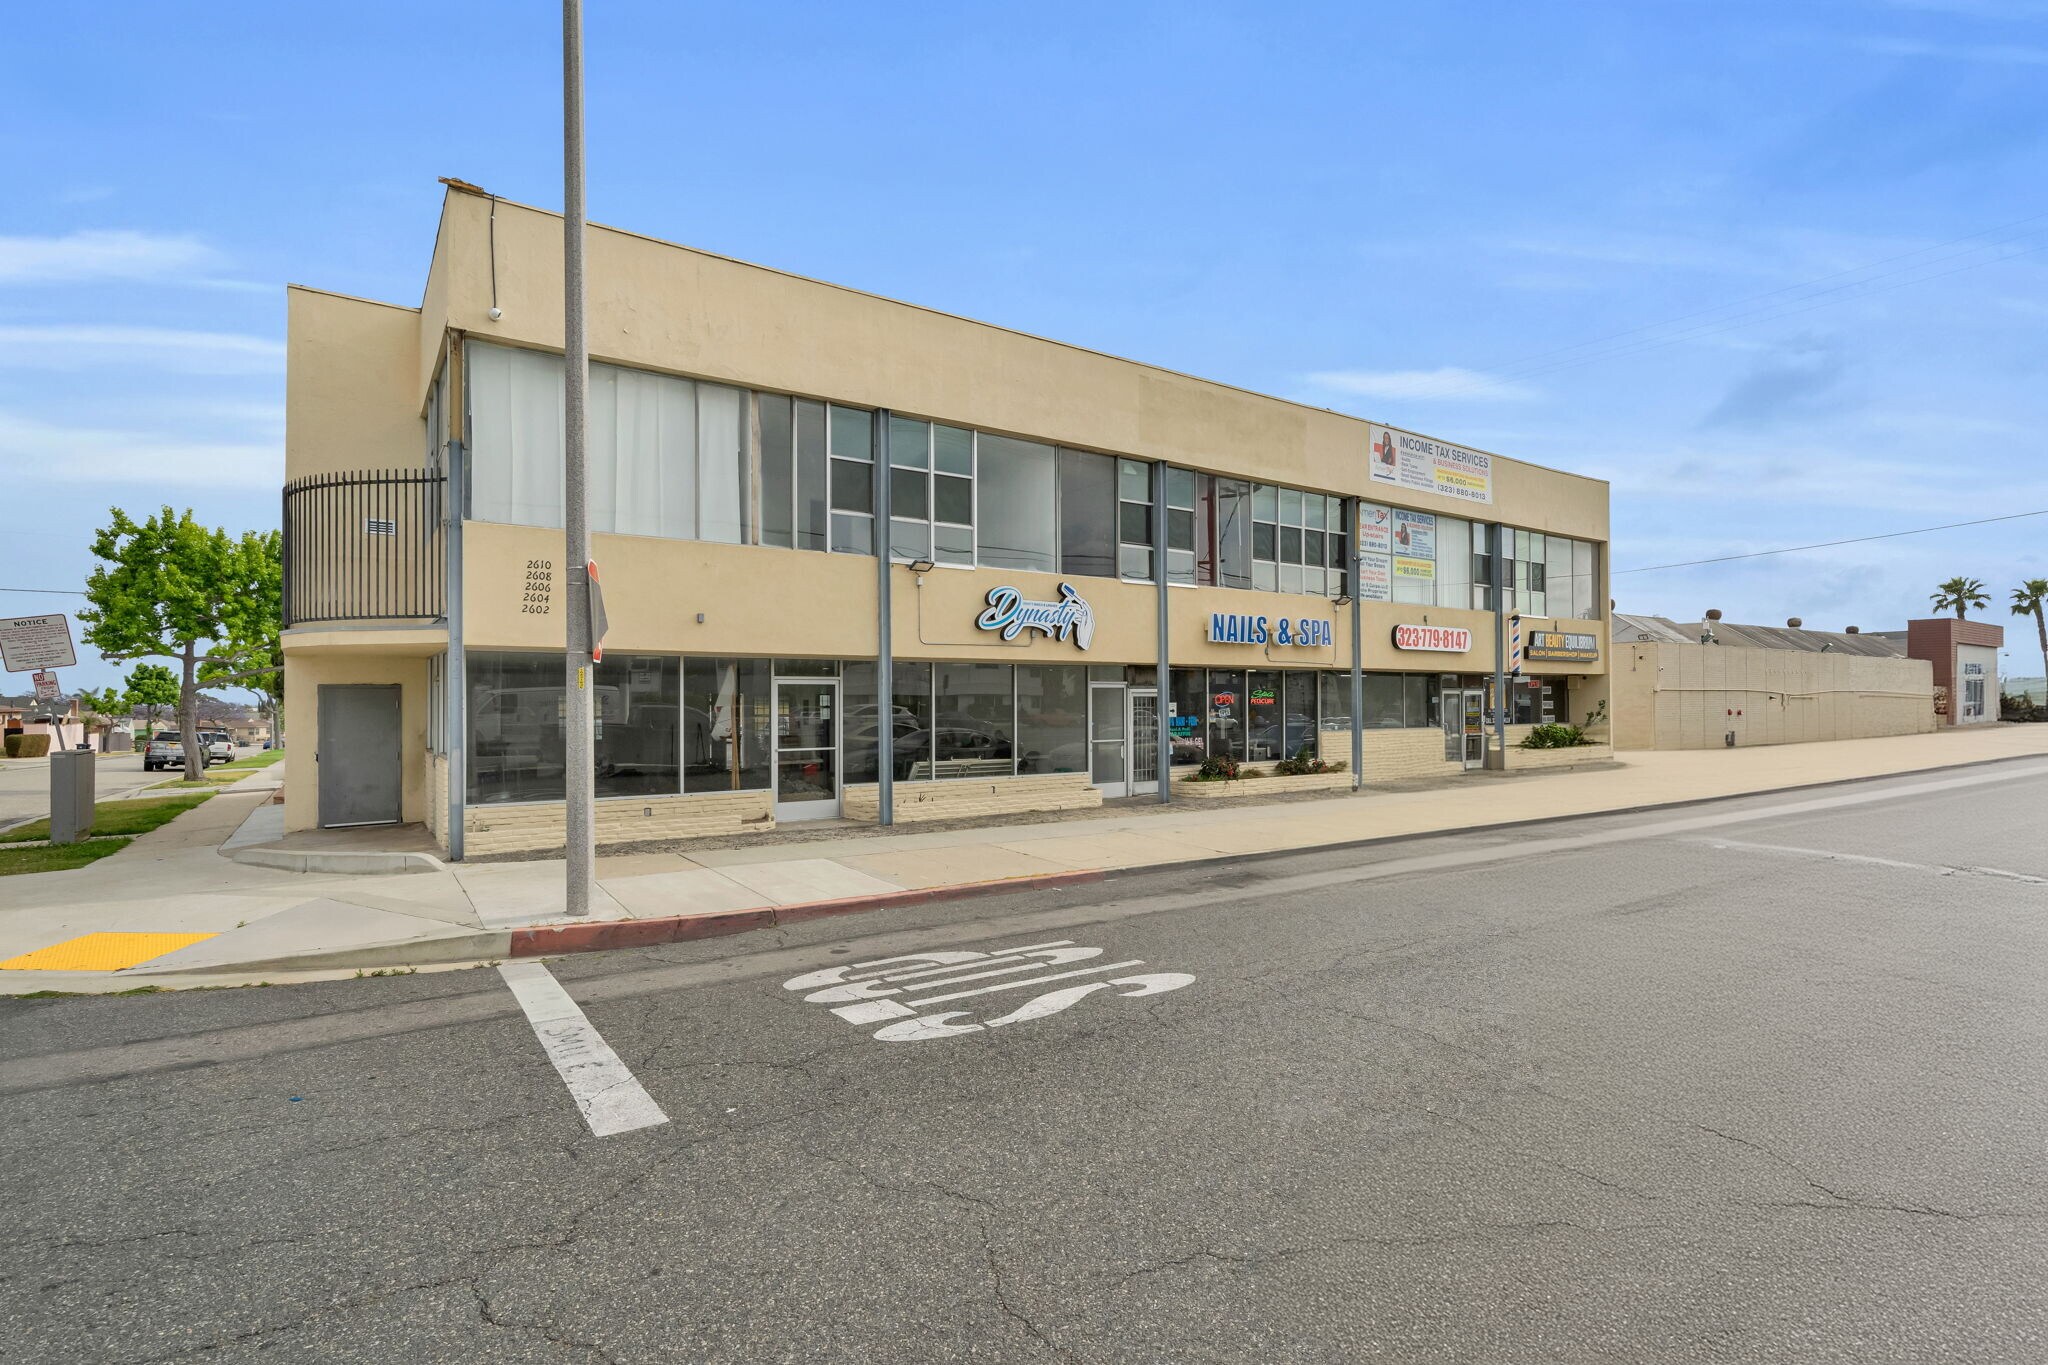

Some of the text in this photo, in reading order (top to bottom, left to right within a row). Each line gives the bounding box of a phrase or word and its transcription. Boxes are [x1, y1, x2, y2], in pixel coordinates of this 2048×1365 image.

[1400, 436, 1488, 468] INCOME TAX SERVICES
[1438, 484, 1454, 494] (323)
[527, 560, 551, 569] 2610
[526, 571, 552, 581] 2608
[525, 582, 551, 592] 2606
[523, 593, 549, 603] 2604
[522, 604, 550, 614] 2602
[980, 588, 1076, 639] Dynasty
[13, 619, 48, 627] NOTICE
[1213, 613, 1332, 646] NAILS & SPA
[1535, 633, 1544, 647] ART
[1546, 634, 1564, 648] BEAUTY
[1251, 689, 1274, 698] Spa
[1215, 694, 1235, 704] OPEN
